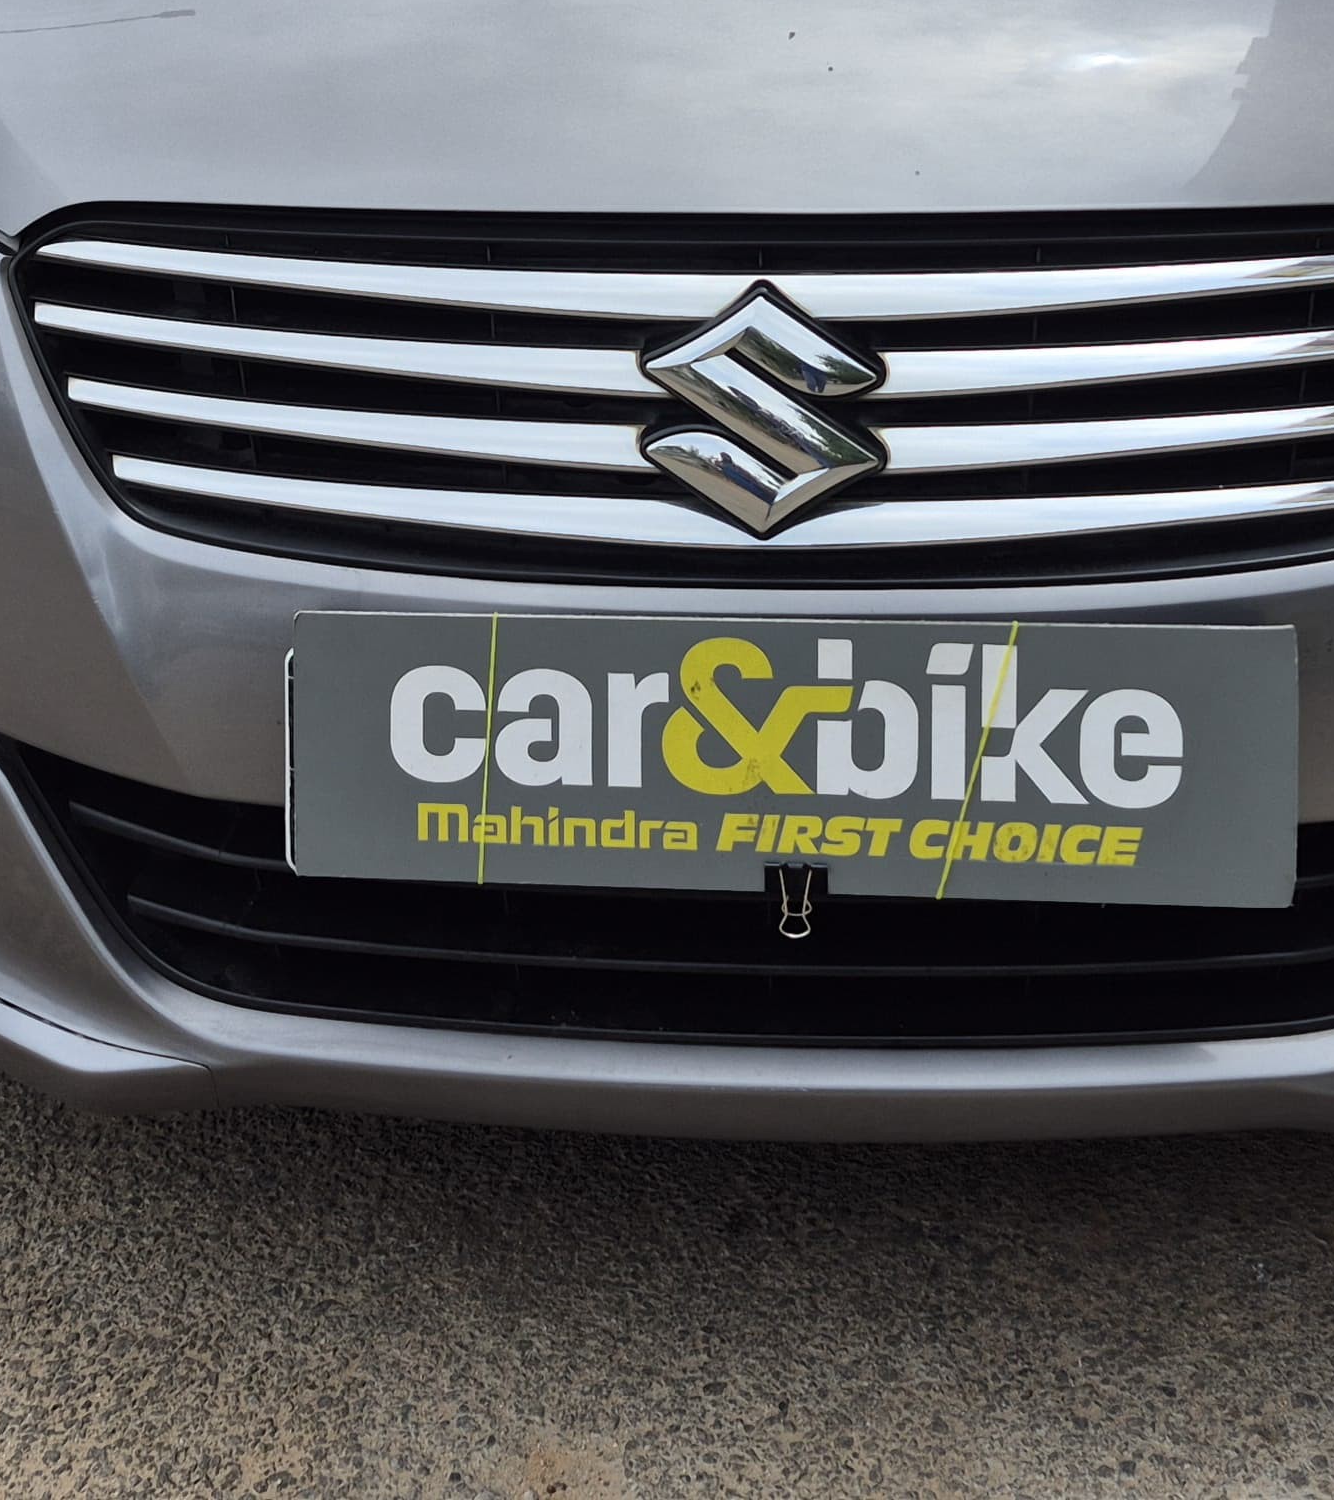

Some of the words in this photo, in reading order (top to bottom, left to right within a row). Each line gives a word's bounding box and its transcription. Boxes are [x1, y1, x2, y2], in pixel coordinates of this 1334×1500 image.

[390, 637, 1184, 809] car&bike
[417, 802, 699, 851] Mahindra
[715, 813, 902, 857] FIRST
[909, 819, 1144, 867] CHOICE
